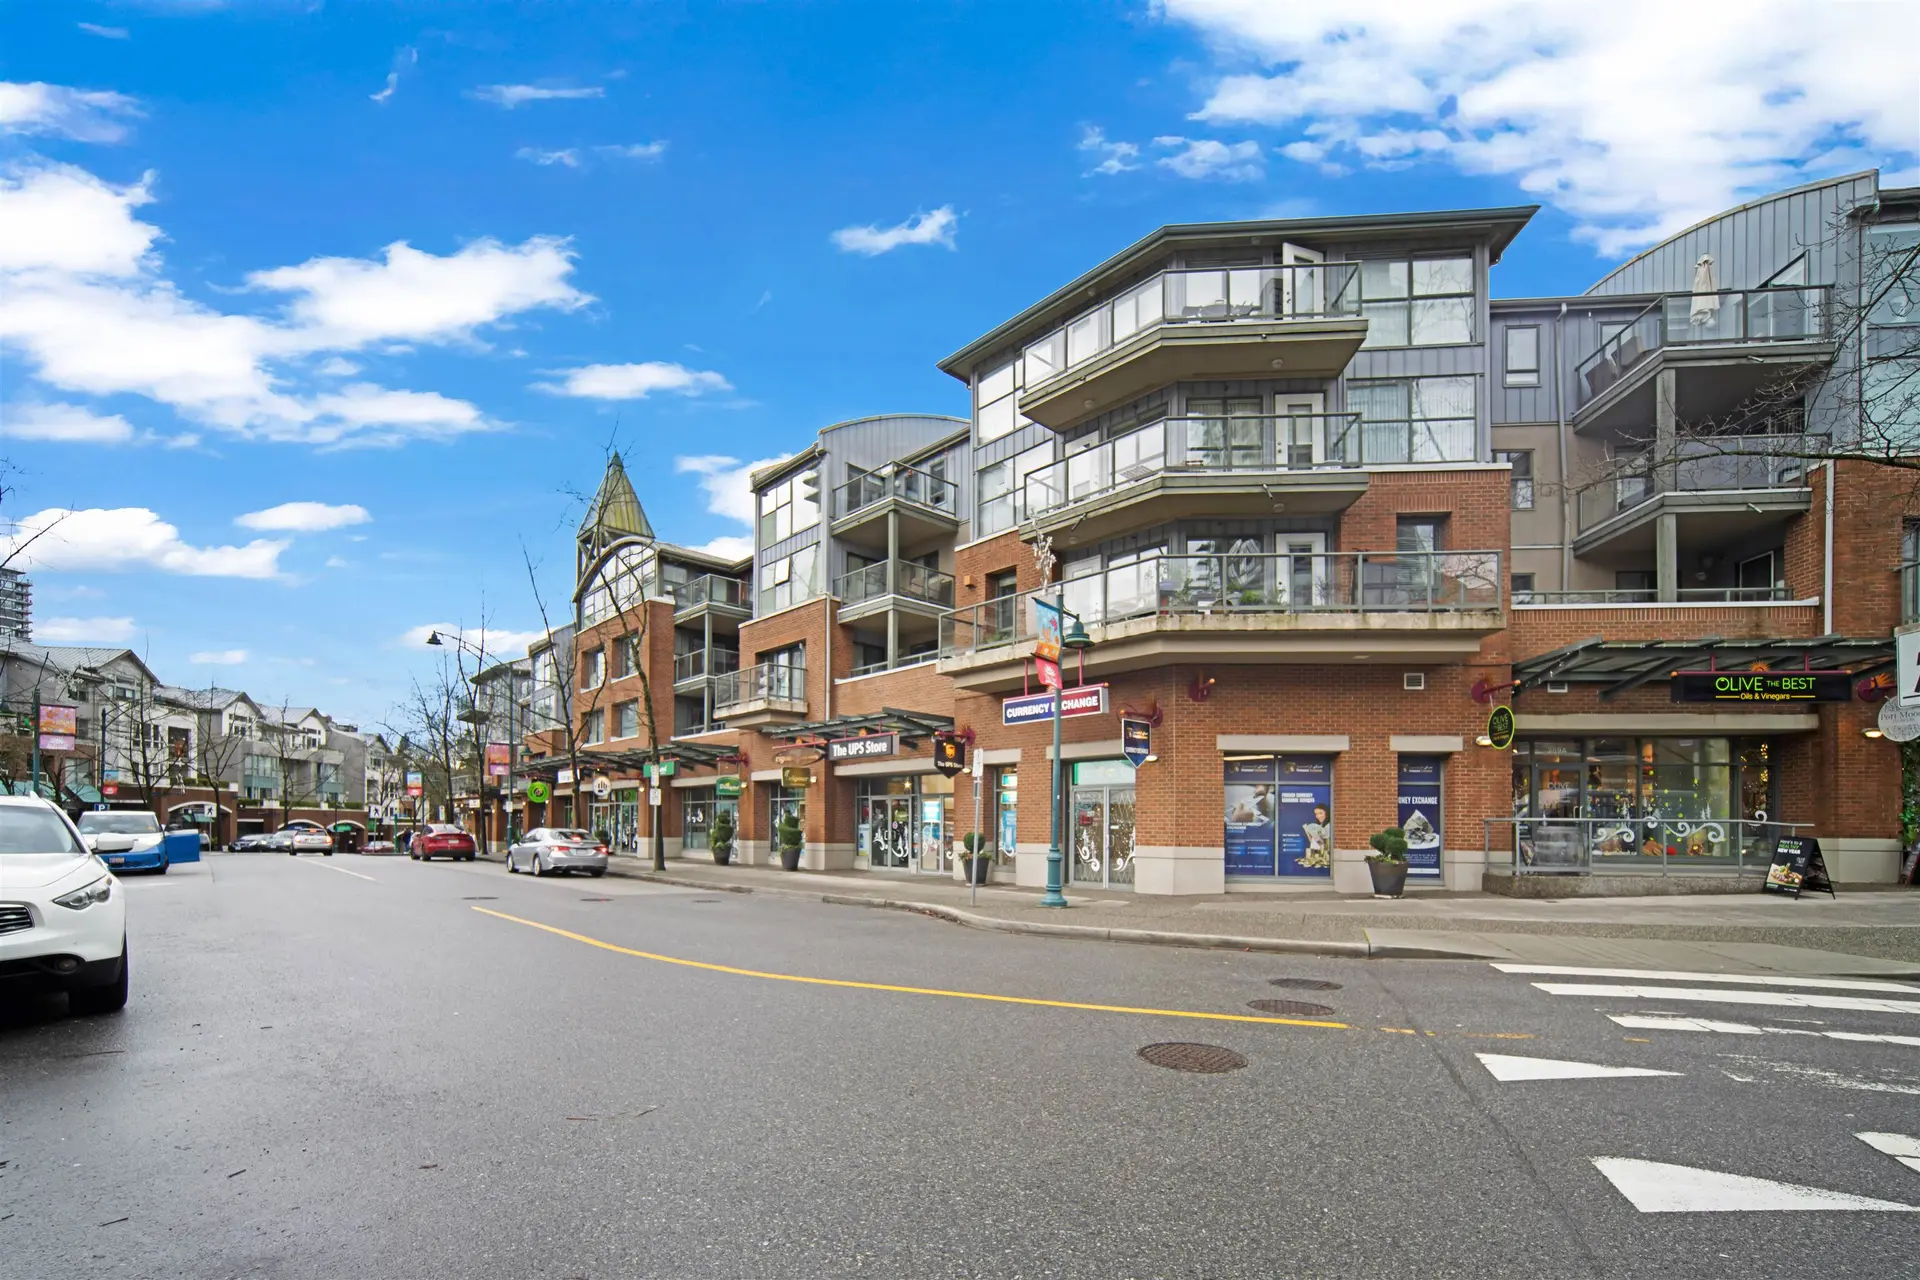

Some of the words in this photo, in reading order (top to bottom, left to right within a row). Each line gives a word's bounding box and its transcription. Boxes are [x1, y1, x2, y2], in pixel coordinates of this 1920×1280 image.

[1715, 677, 1764, 691] OLIVE
[1782, 677, 1816, 690] BEST
[1740, 692, 1752, 700] Oils
[1754, 692, 1760, 700] &
[1760, 692, 1791, 702] Vinegars
[1006, 702, 1050, 718] CURRENCY
[1051, 695, 1098, 712] ECHANGE
[833, 744, 847, 756] The
[848, 741, 865, 755] UPS
[865, 741, 887, 753] Store
[1398, 796, 1411, 804] ONEY
[1412, 796, 1438, 804] EXCHANGE
